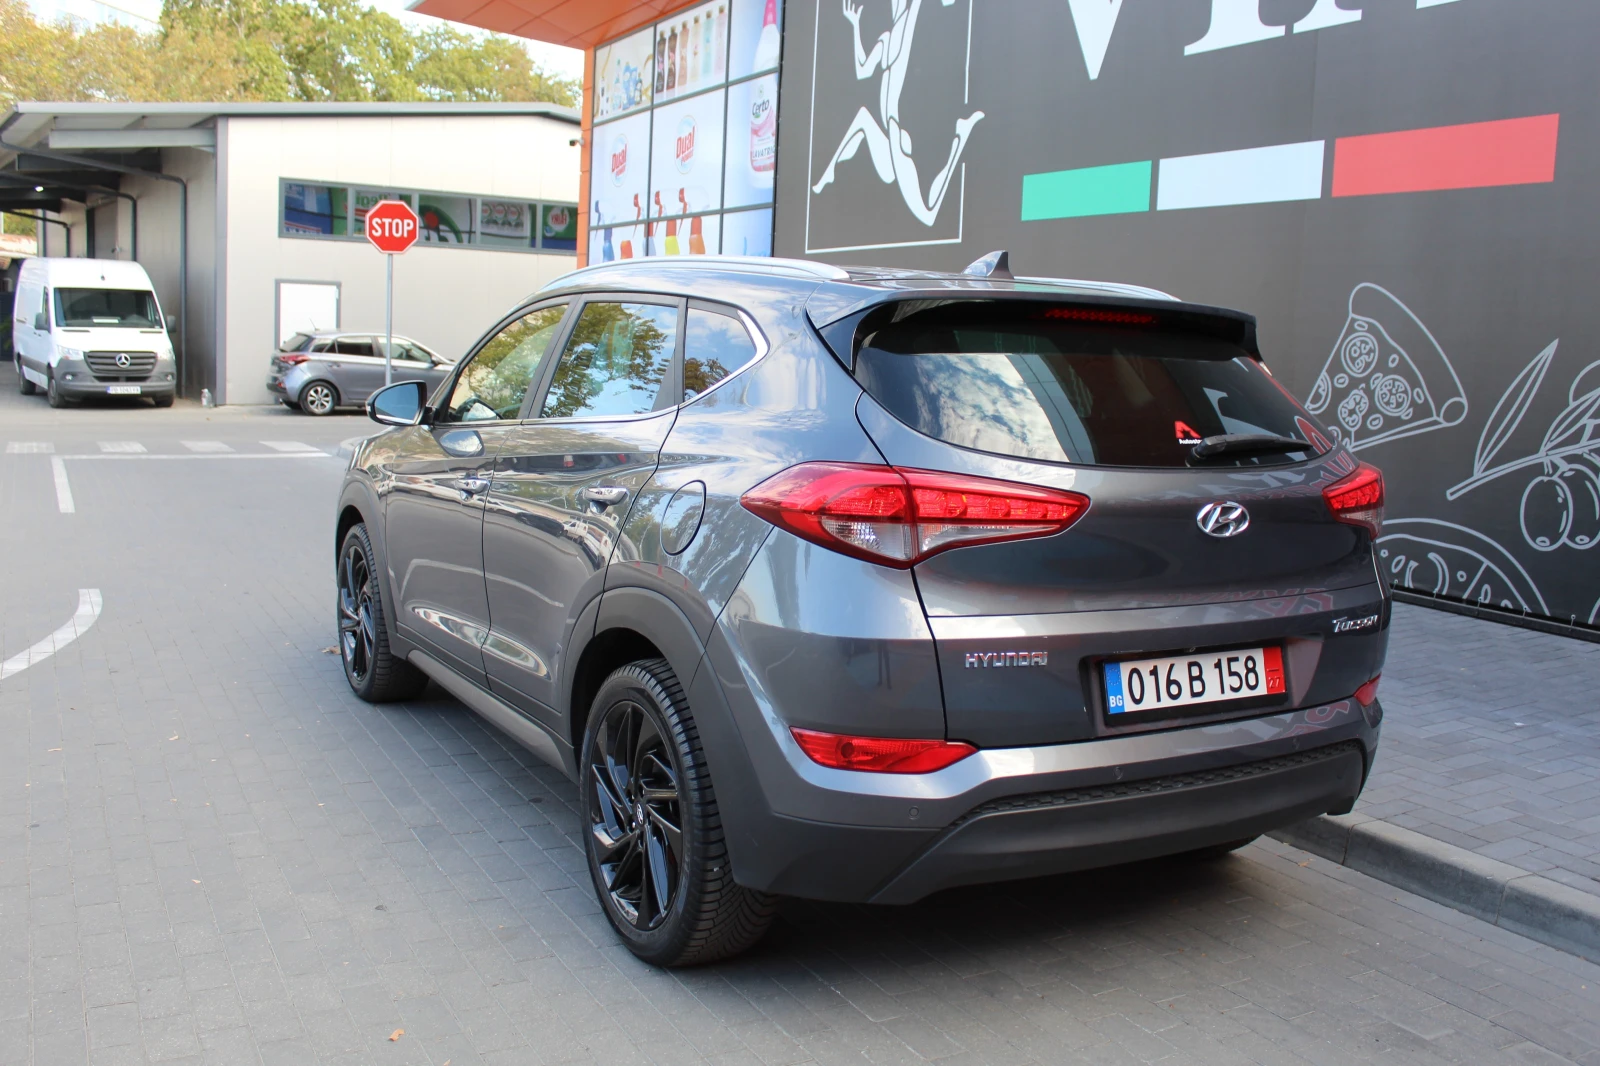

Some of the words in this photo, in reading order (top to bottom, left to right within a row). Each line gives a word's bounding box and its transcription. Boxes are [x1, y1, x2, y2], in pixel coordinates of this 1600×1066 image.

[752, 99, 770, 116] Certo
[676, 125, 695, 159] Dual
[611, 143, 628, 173] Dual
[371, 217, 414, 238] STOP
[965, 651, 1048, 668] HYUNDAI
[1109, 695, 1123, 708] BG
